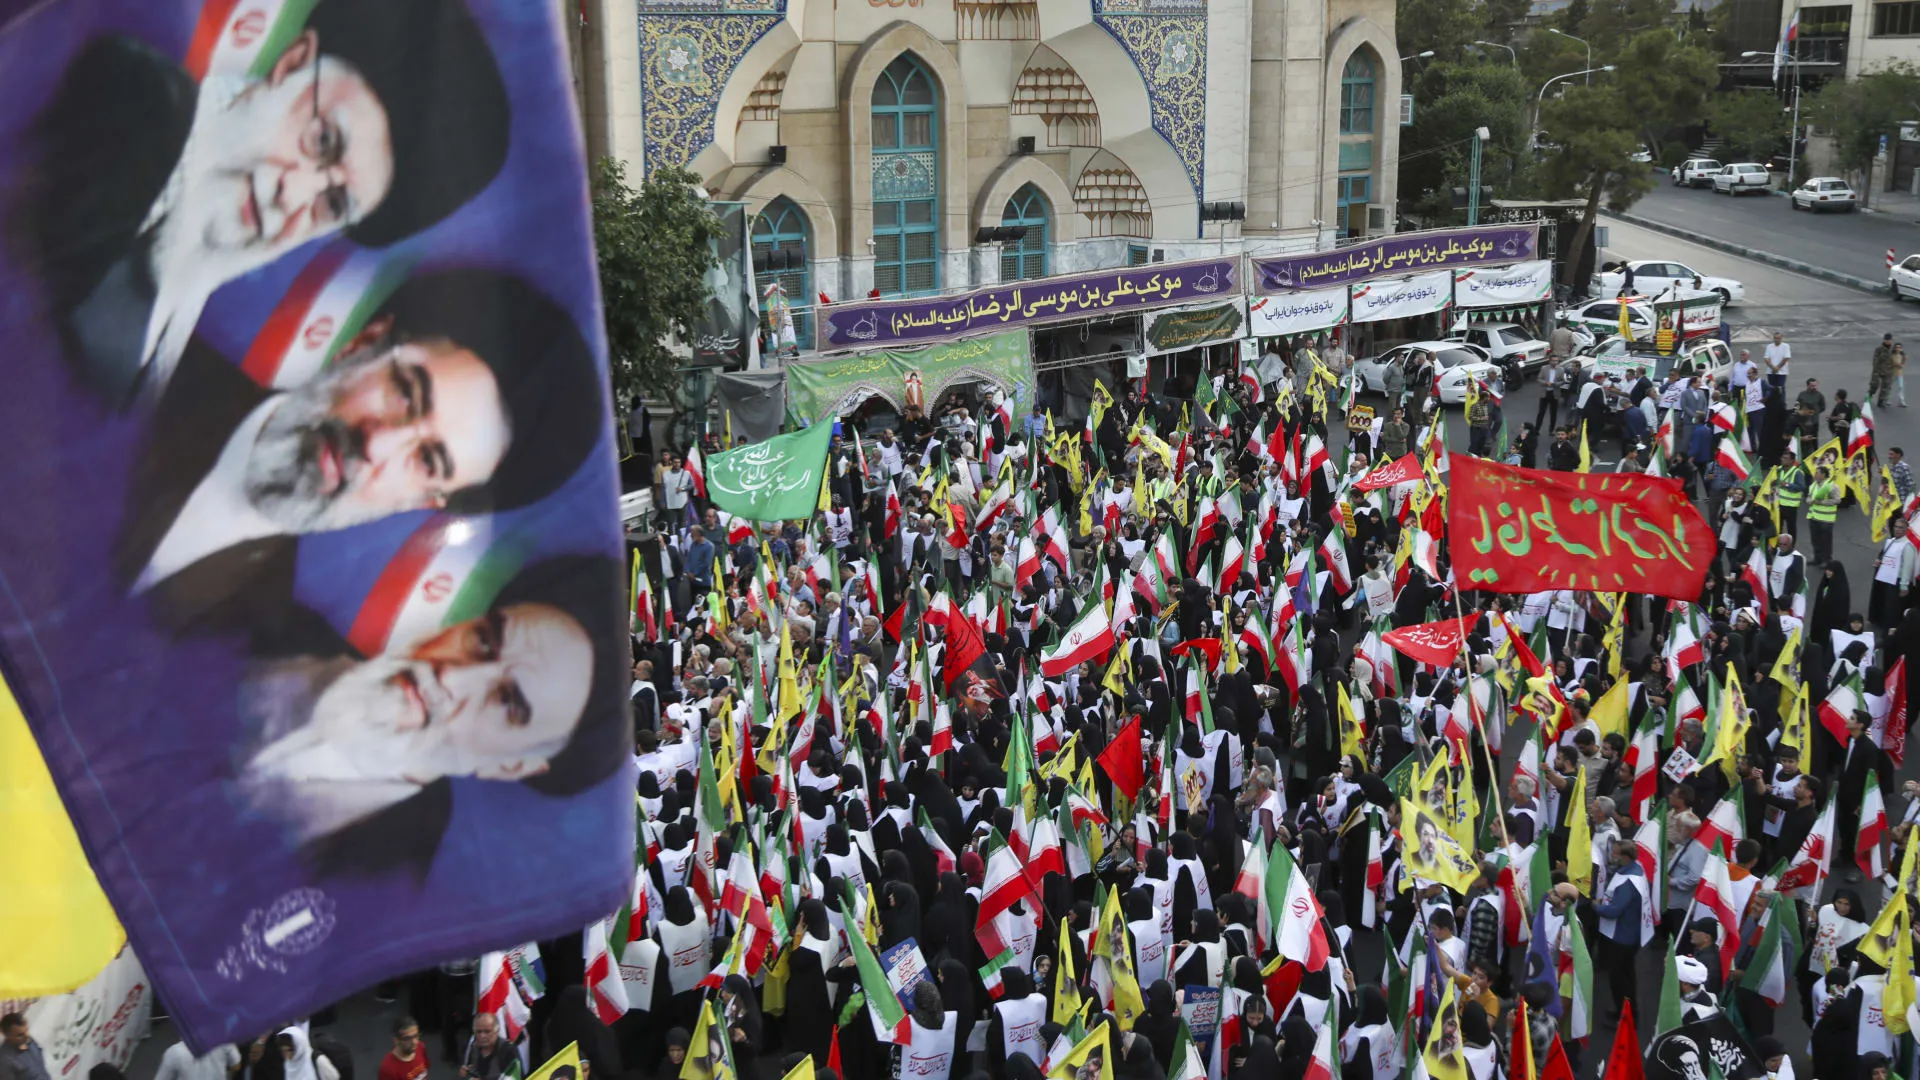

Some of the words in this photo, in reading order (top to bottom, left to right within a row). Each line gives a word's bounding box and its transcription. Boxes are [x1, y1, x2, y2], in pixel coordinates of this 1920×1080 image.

[1383, 248, 1421, 269] موسی
[1420, 243, 1436, 263] بن
[1435, 238, 1459, 262] علی
[1458, 237, 1494, 261] موکب
[1349, 246, 1384, 273] الرضا
[1101, 275, 1135, 306] علی
[1135, 273, 1182, 303] موکب
[1489, 277, 1515, 290] نوجوان
[1514, 274, 1538, 288] پاتوق
[1023, 289, 1078, 317] موسی
[1078, 284, 1100, 309] بن
[1367, 294, 1389, 308] ایرانی
[1388, 289, 1417, 304] نوجوان
[1416, 286, 1437, 300] پاتوق
[969, 289, 1022, 322] الرضا
[1265, 306, 1286, 320] ایرانی
[1285, 303, 1313, 318] نوجوان
[1311, 300, 1334, 314] پاتوق
